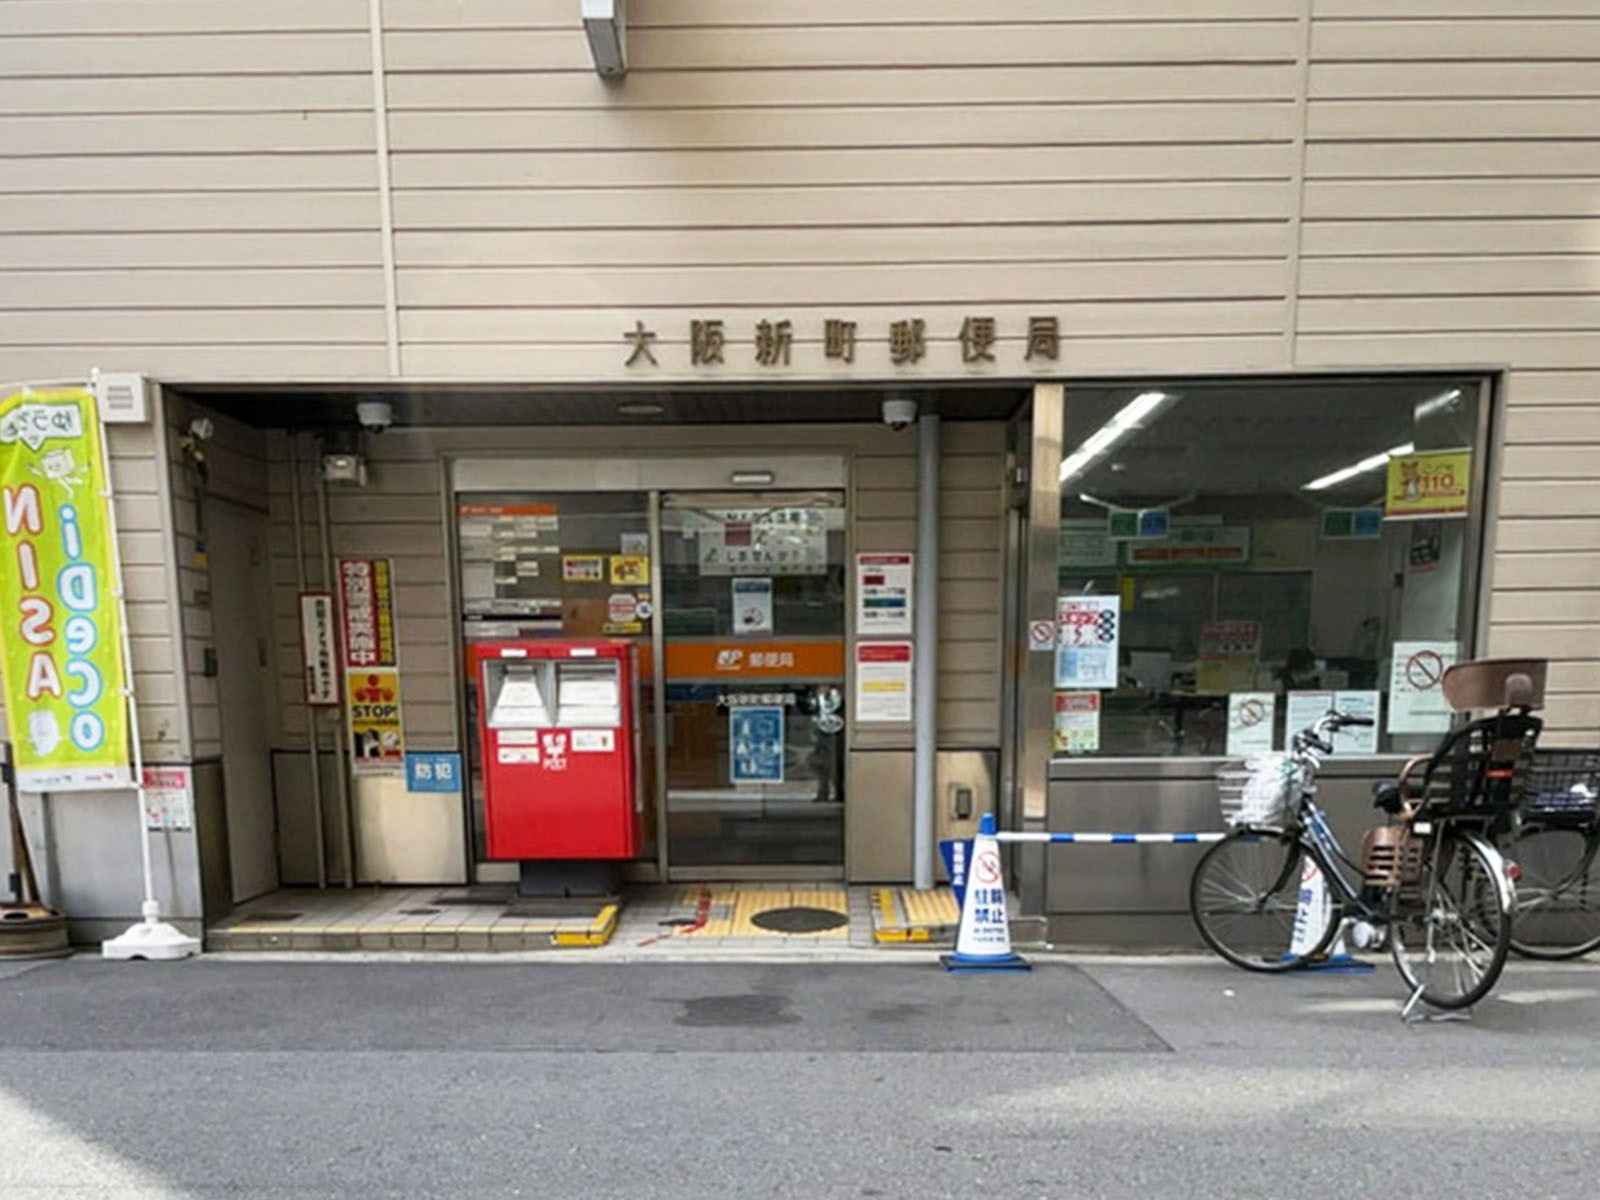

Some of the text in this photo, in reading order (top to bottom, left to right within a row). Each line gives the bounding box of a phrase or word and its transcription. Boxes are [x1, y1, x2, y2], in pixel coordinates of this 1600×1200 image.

[623, 316, 1061, 366] 大阪新町郵便局
[749, 652, 794, 667] 郵便局
